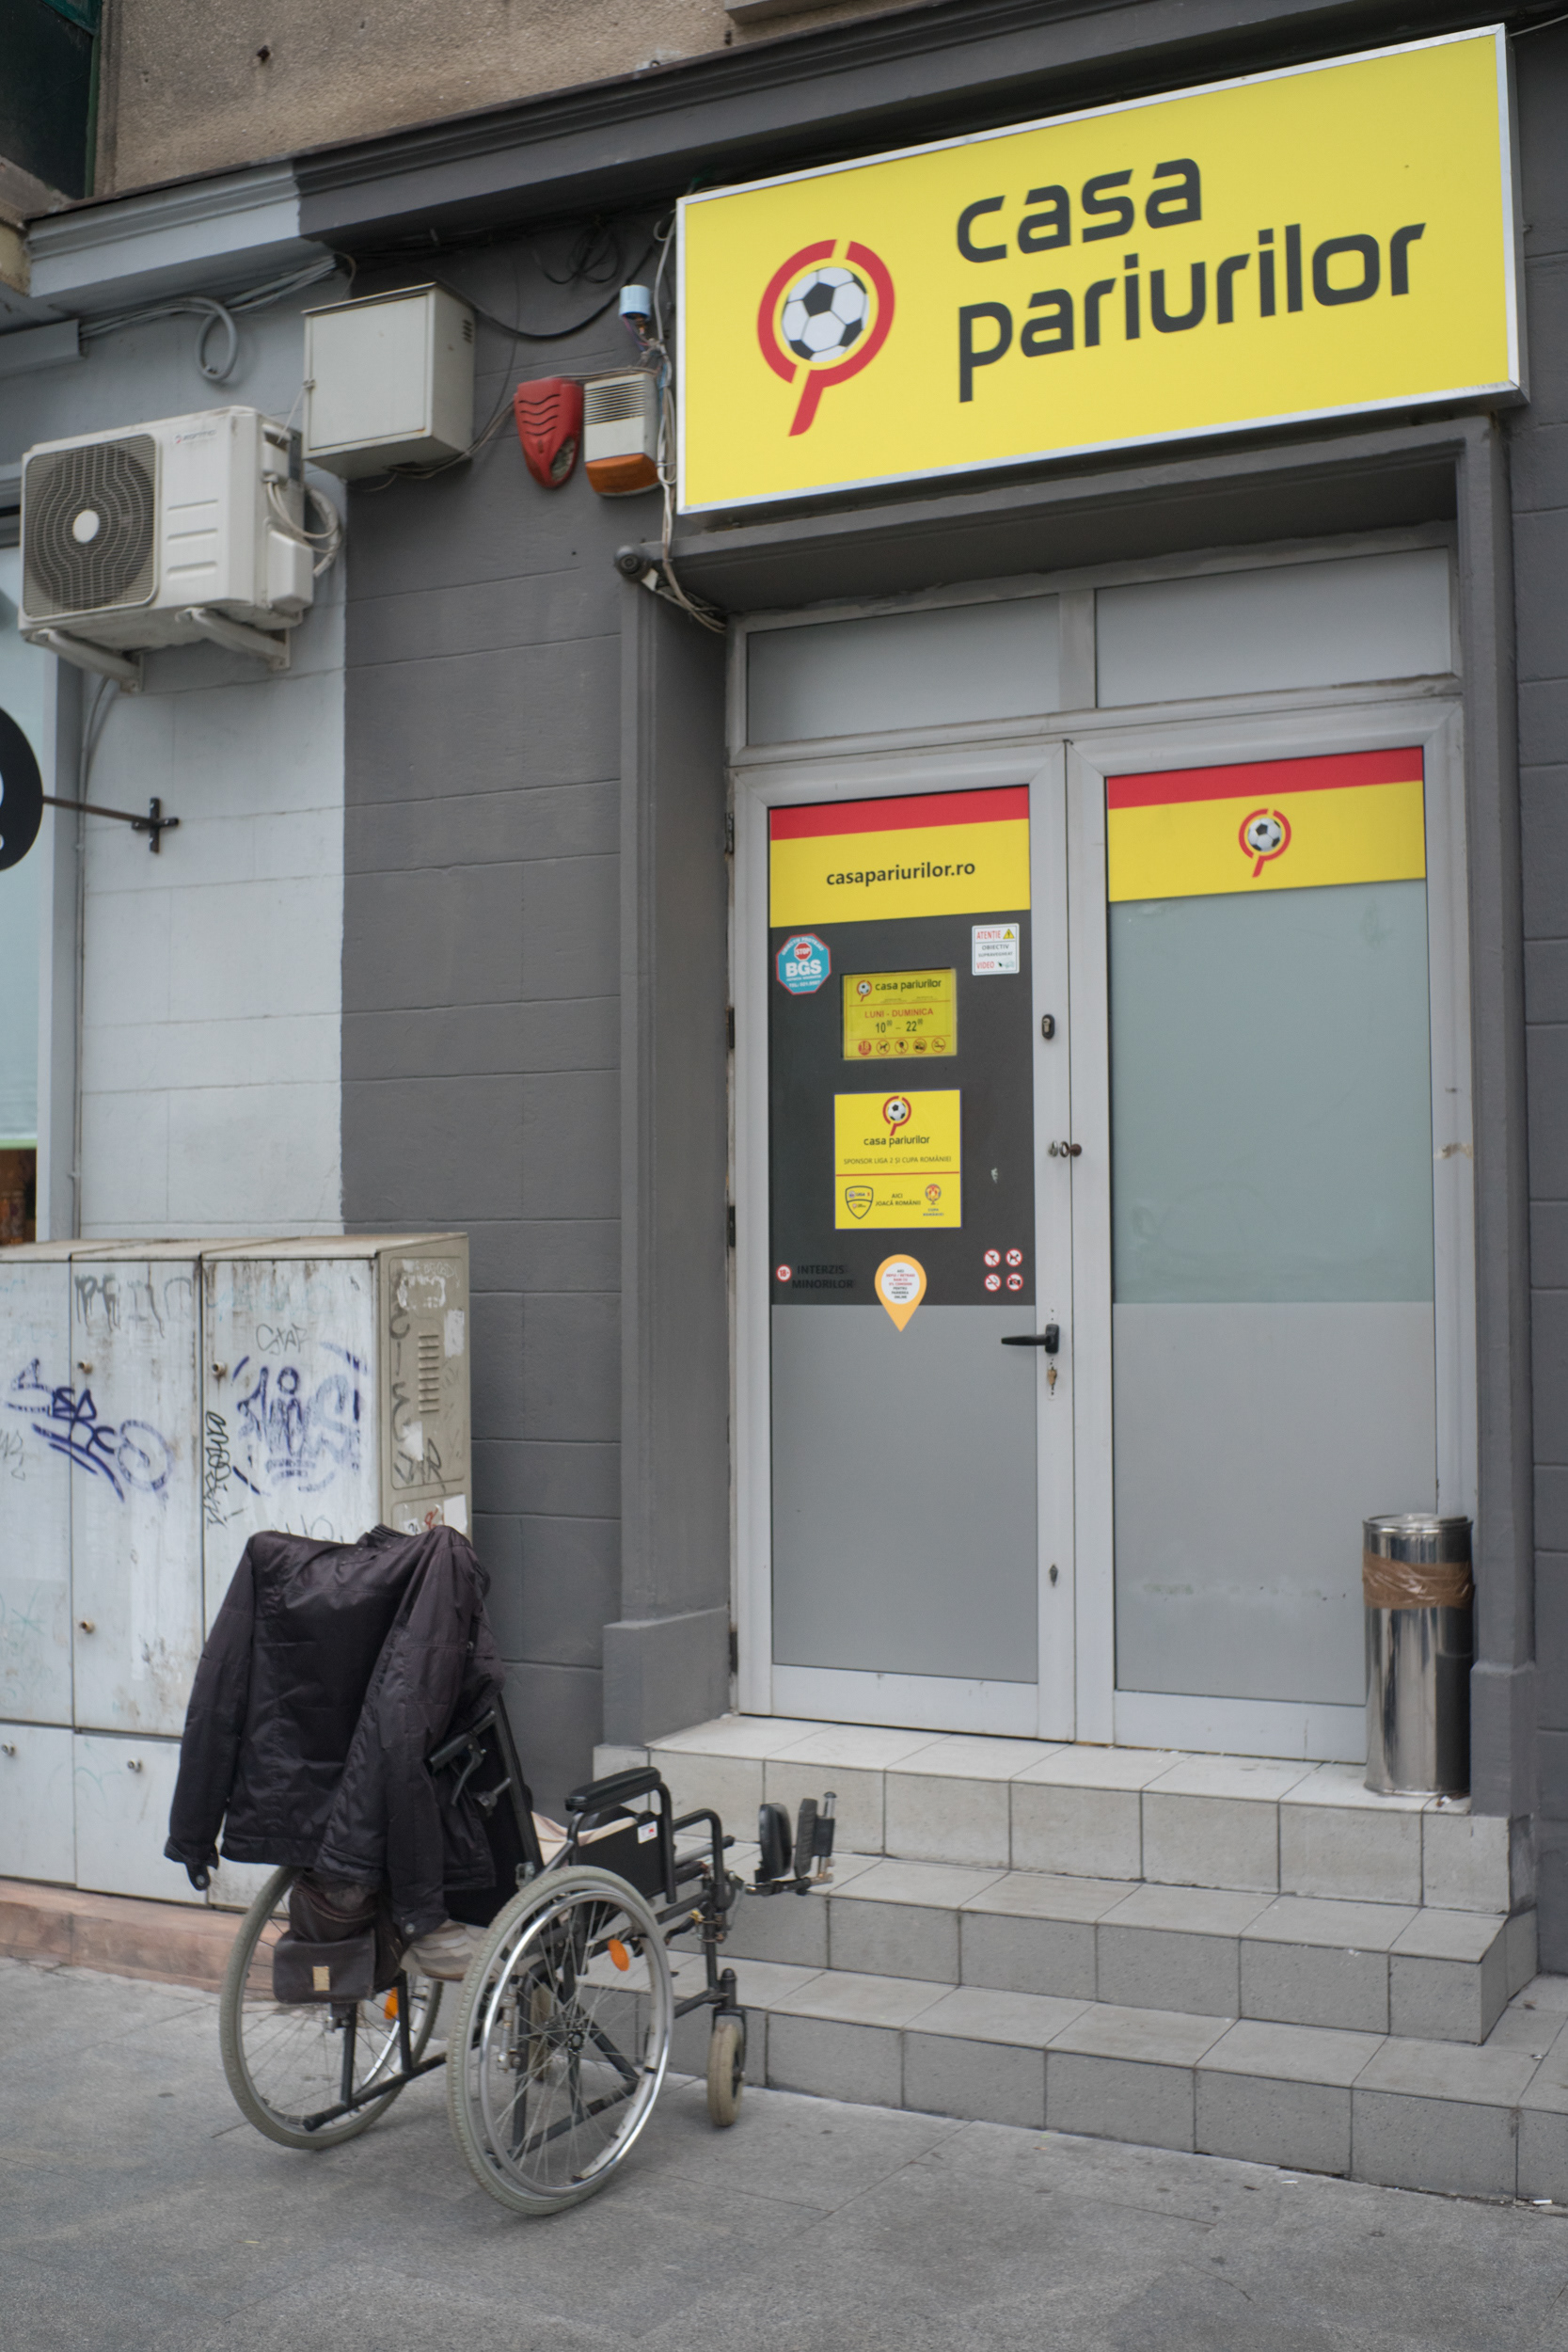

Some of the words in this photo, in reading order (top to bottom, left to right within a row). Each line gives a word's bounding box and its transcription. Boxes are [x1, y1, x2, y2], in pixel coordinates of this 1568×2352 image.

[956, 157, 1203, 263] casa
[958, 222, 1427, 404] pariurilor
[826, 861, 975, 887] casapariurilor.ro
[795, 947, 811, 956] STOP
[785, 959, 822, 977] BGS
[976, 961, 995, 969] VIDEO
[875, 981, 898, 991] casa
[900, 978, 942, 993] pariurilor
[864, 1009, 884, 1018] LUNI
[892, 1008, 933, 1017] DUMINICA
[863, 1137, 887, 1146] casa
[889, 1135, 930, 1148] pariurilor
[797, 1264, 846, 1275] INTERZIS
[792, 1279, 854, 1289] MINORILOR
